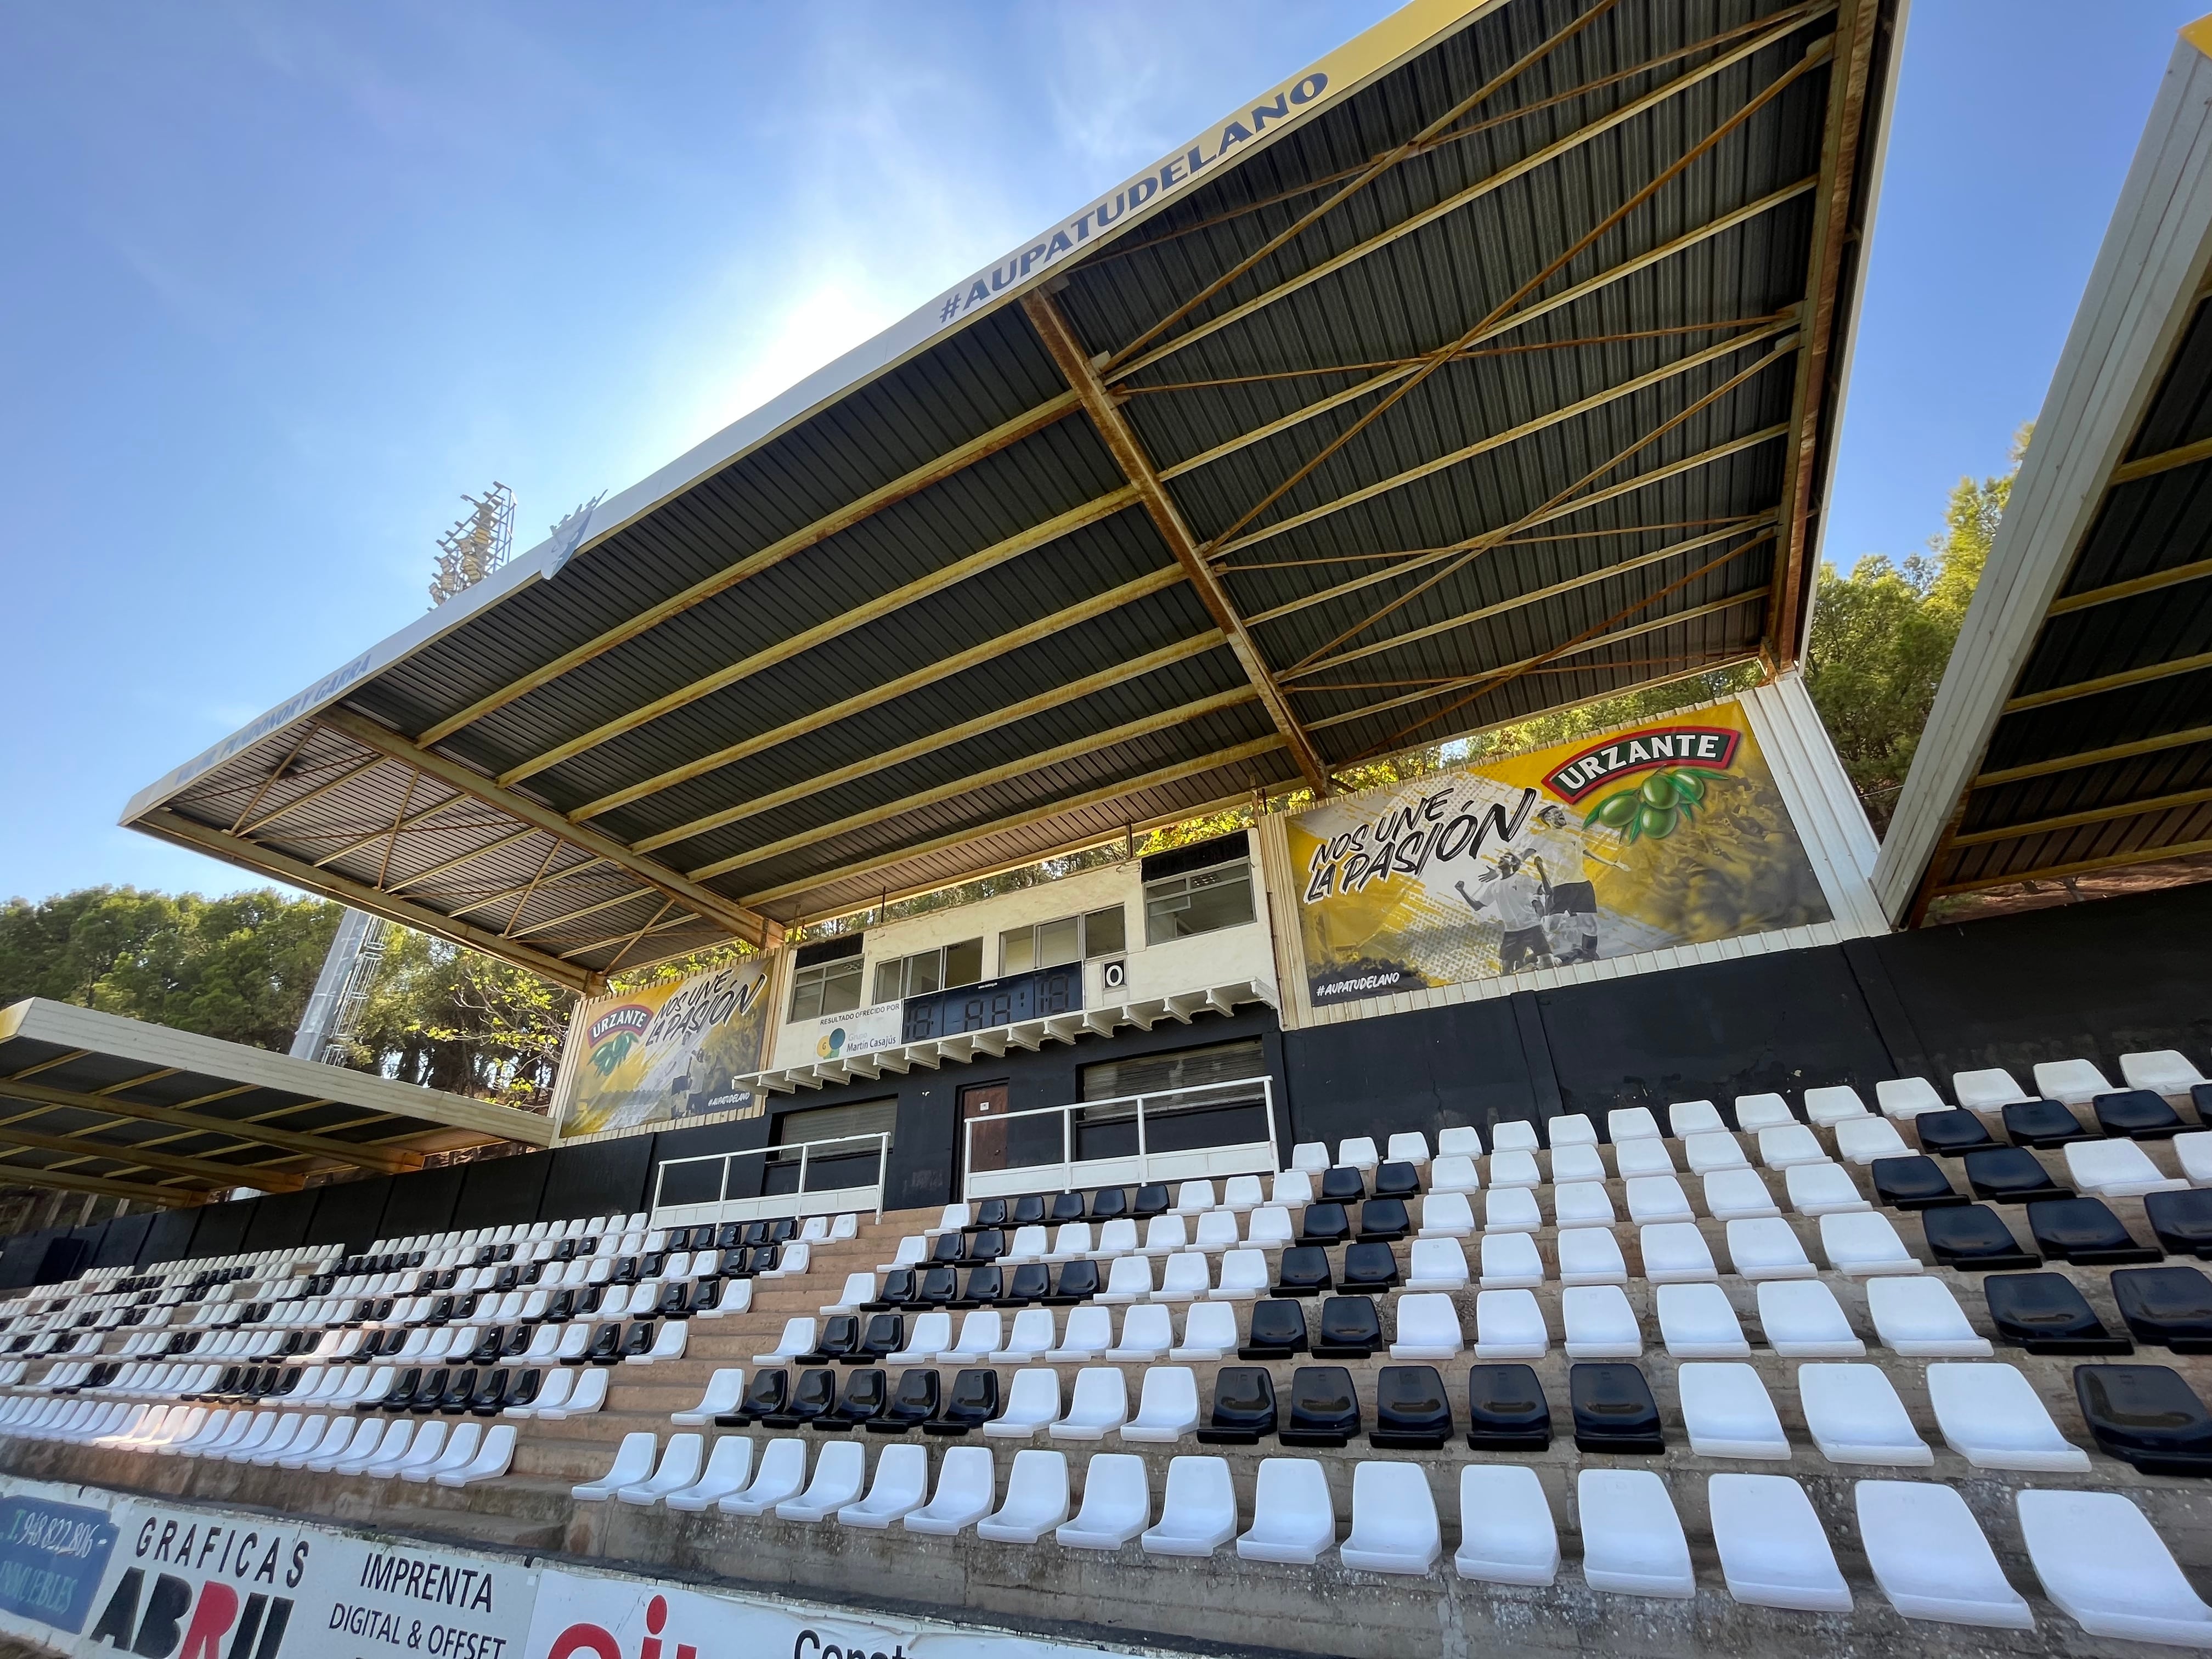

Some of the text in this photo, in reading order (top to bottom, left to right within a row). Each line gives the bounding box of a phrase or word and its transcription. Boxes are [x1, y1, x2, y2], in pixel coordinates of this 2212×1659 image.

[939, 72, 1329, 323] #AUPATUDELANO
[300, 691, 314, 711] Y
[314, 654, 371, 703] GARRA
[1558, 735, 1719, 790] URZANTE
[1307, 787, 1537, 902] LA PASIÓN
[1312, 787, 1454, 872] NOS UNE
[645, 973, 766, 1047] LA PASIÓN
[654, 969, 732, 1024] NOS UNE
[1317, 972, 1400, 996] #AUPATUDELANO
[593, 1009, 647, 1038] URZANTE
[820, 1003, 900, 1025] RESULTADO OFRECIDO POR
[848, 1032, 868, 1041] Grupo
[870, 1035, 896, 1048] Casajús
[136, 1516, 309, 1589] GRAFICAS
[360, 1553, 492, 1613] IMPRENTA
[329, 1602, 401, 1645] DIGITAL
[407, 1620, 422, 1650] &
[428, 1624, 507, 1659] OFFSET
